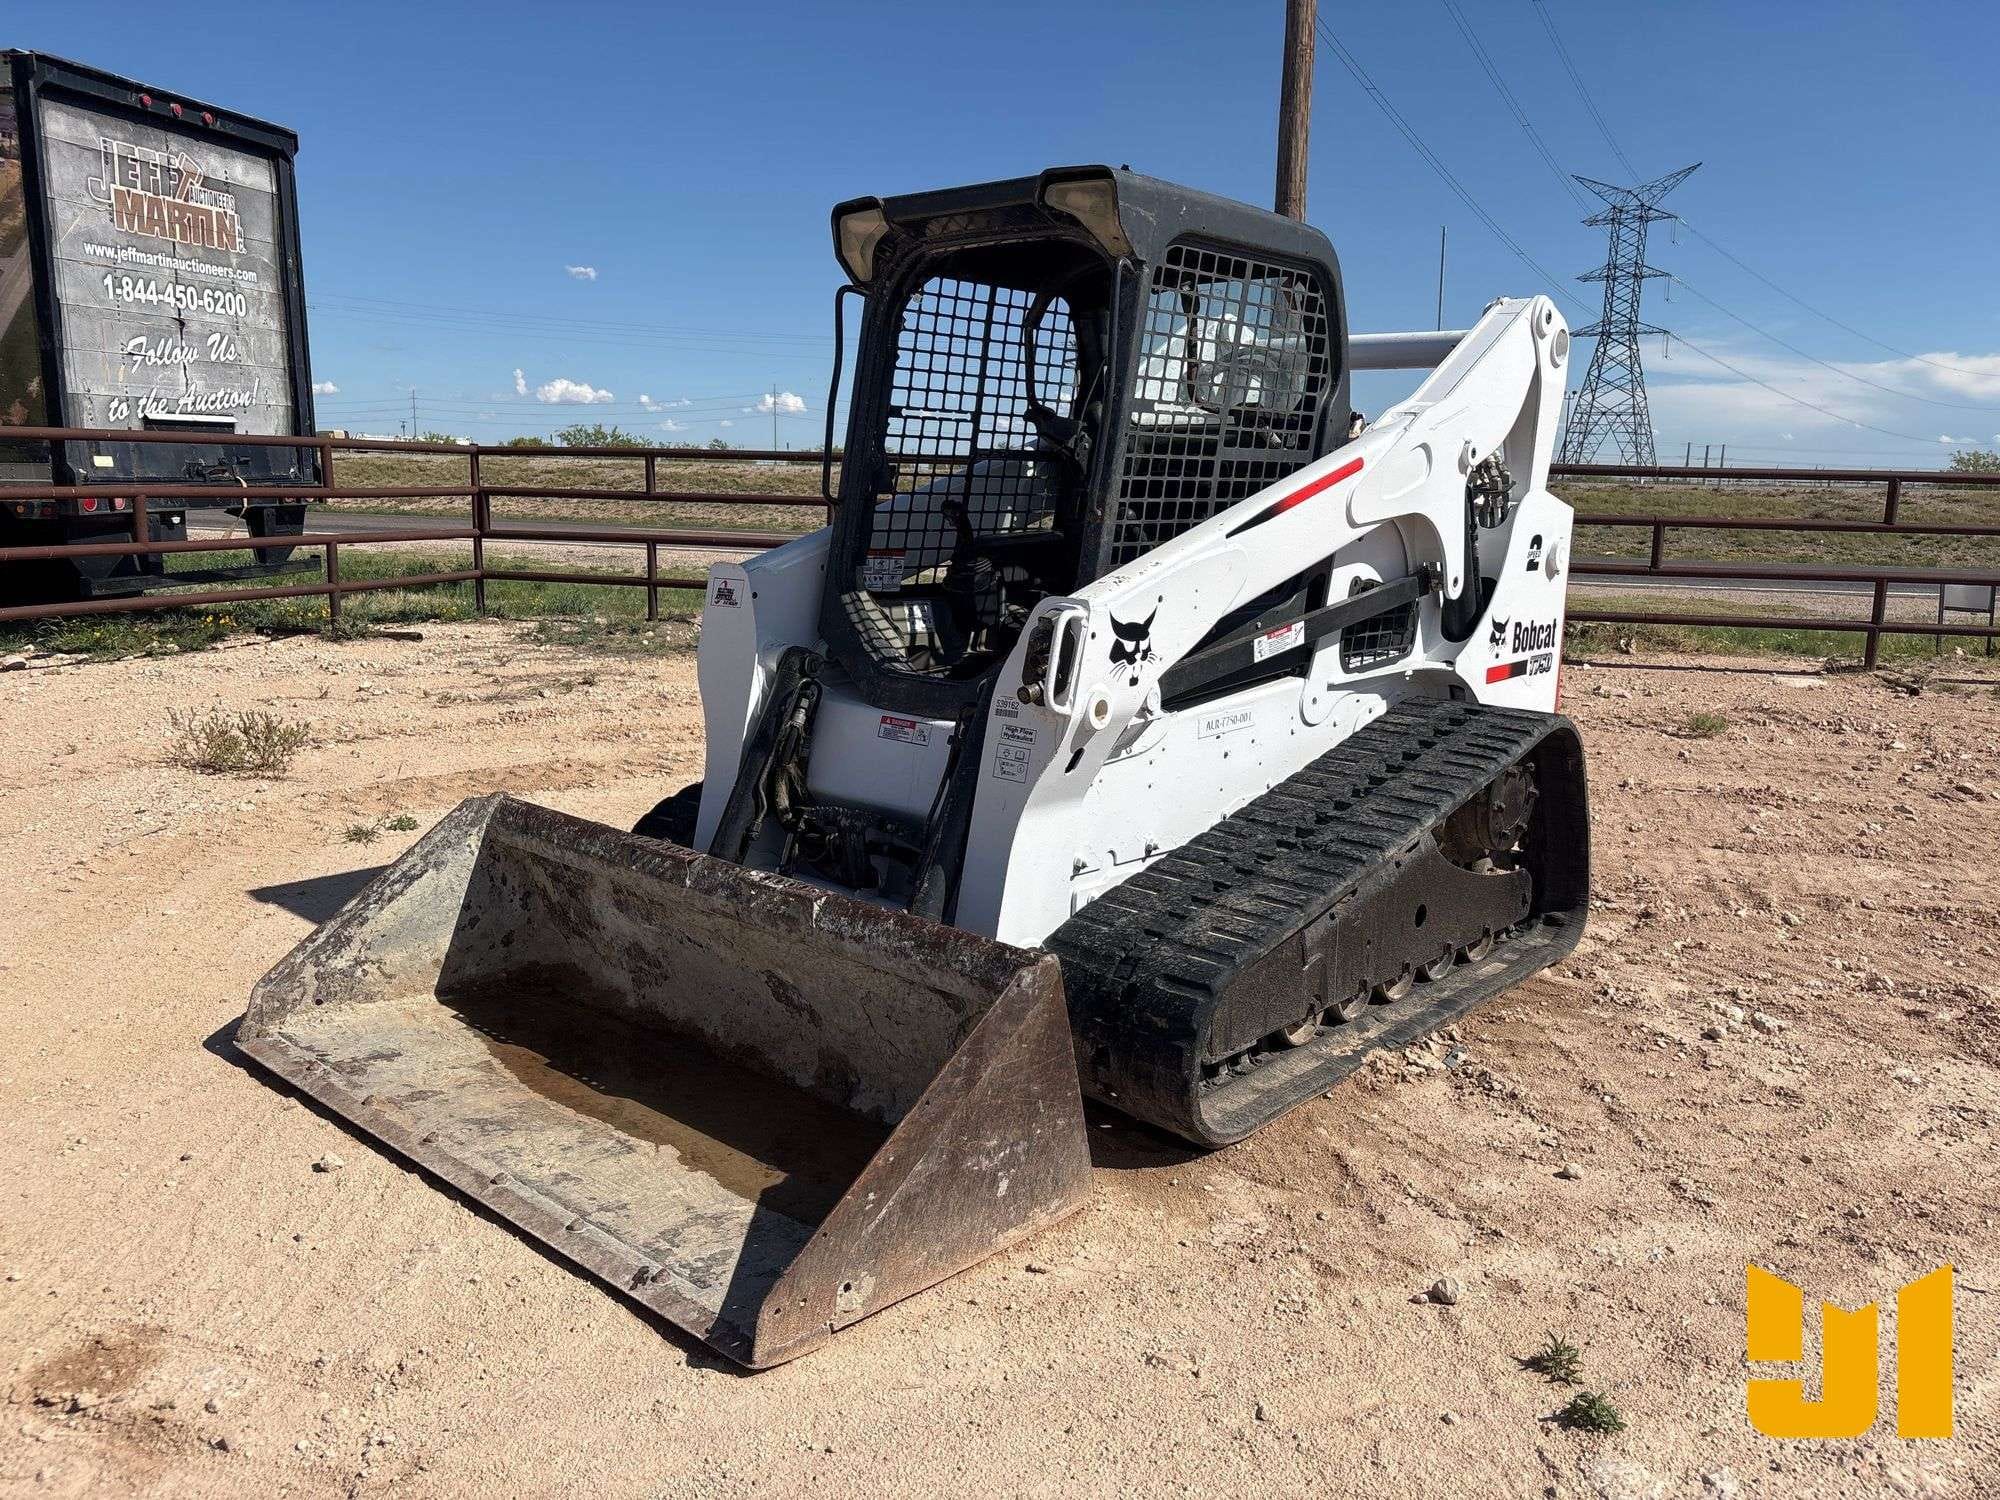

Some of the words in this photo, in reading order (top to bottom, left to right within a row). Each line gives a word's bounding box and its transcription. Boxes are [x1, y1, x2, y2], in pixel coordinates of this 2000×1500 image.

[88, 136, 179, 203] JEFF
[110, 186, 239, 253] MARTIN
[188, 184, 236, 213] AUCTIONEERS
[83, 243, 258, 283] www.jeffmartinauctioneers.com
[103, 273, 247, 318] 1-844-450-6200
[126, 335, 200, 374] Follow
[206, 332, 238, 362] Us
[108, 397, 130, 422] to
[136, 387, 169, 419] the
[176, 376, 260, 415] Auction!
[1512, 618, 1557, 654] Bobcat
[1528, 652, 1553, 676] T750
